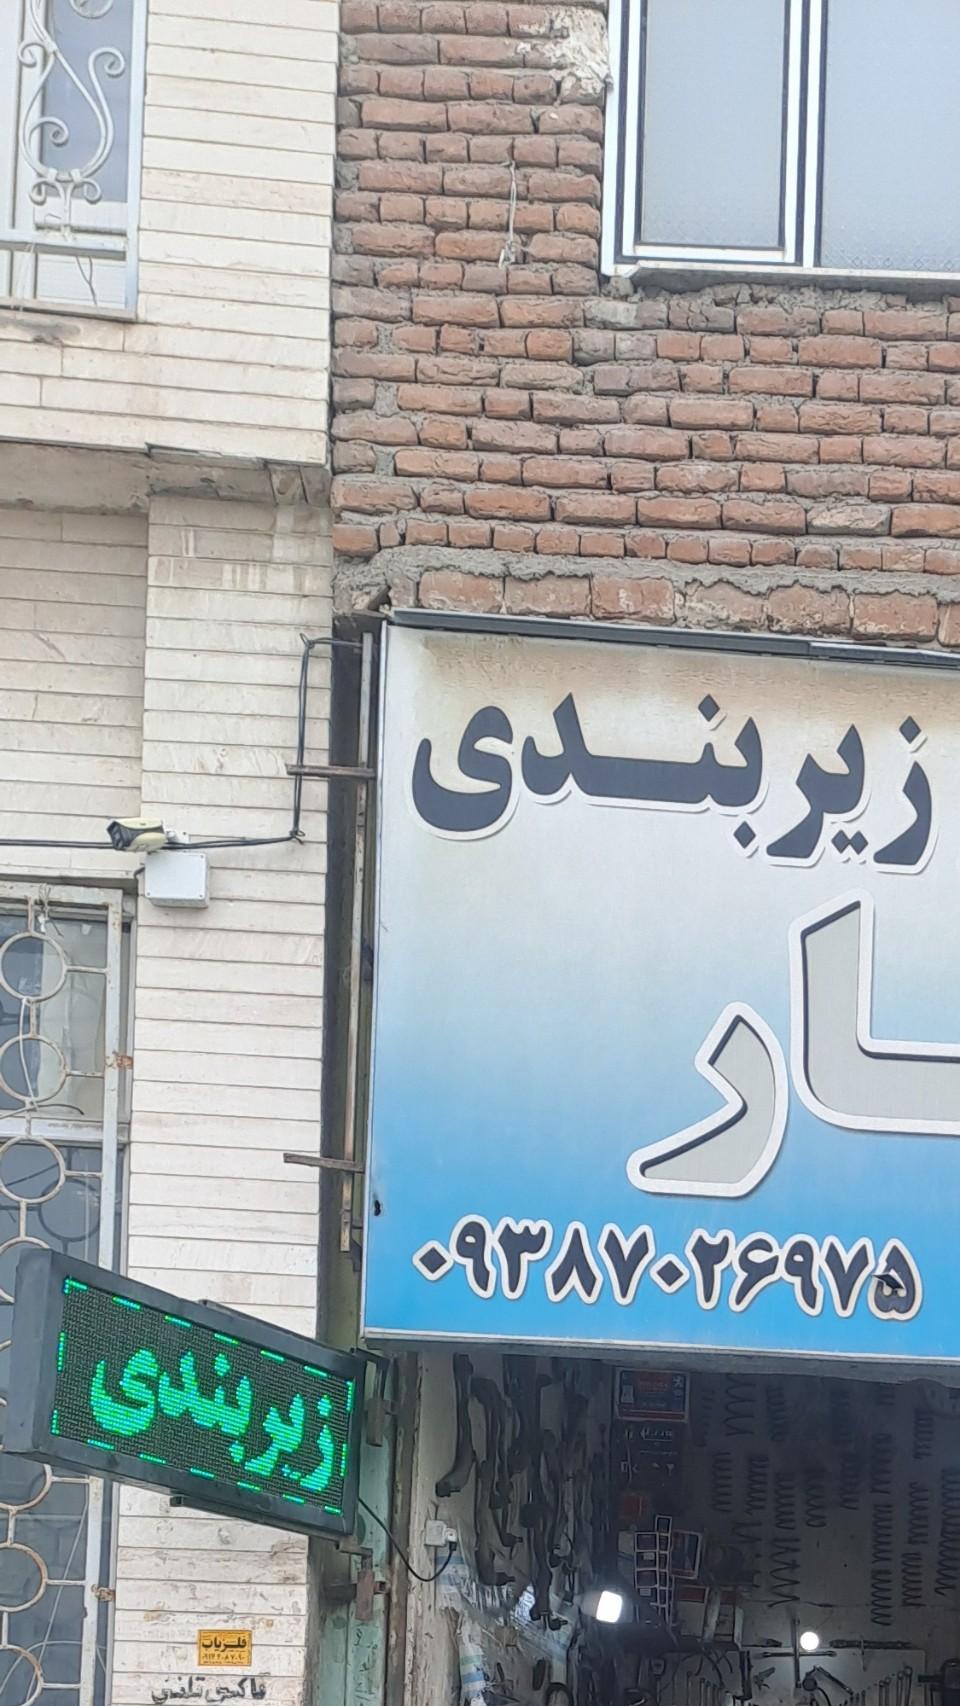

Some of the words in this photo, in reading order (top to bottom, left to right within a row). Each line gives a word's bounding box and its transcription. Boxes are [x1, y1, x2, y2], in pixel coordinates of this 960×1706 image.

[410, 690, 934, 869] زیربندی
[415, 1216, 921, 1319] ۰۹۳۸۷۰۲۶۹۷۵
[90, 1348, 334, 1492] زیربندی
[201, 1635, 247, 1653] فلزیاب
